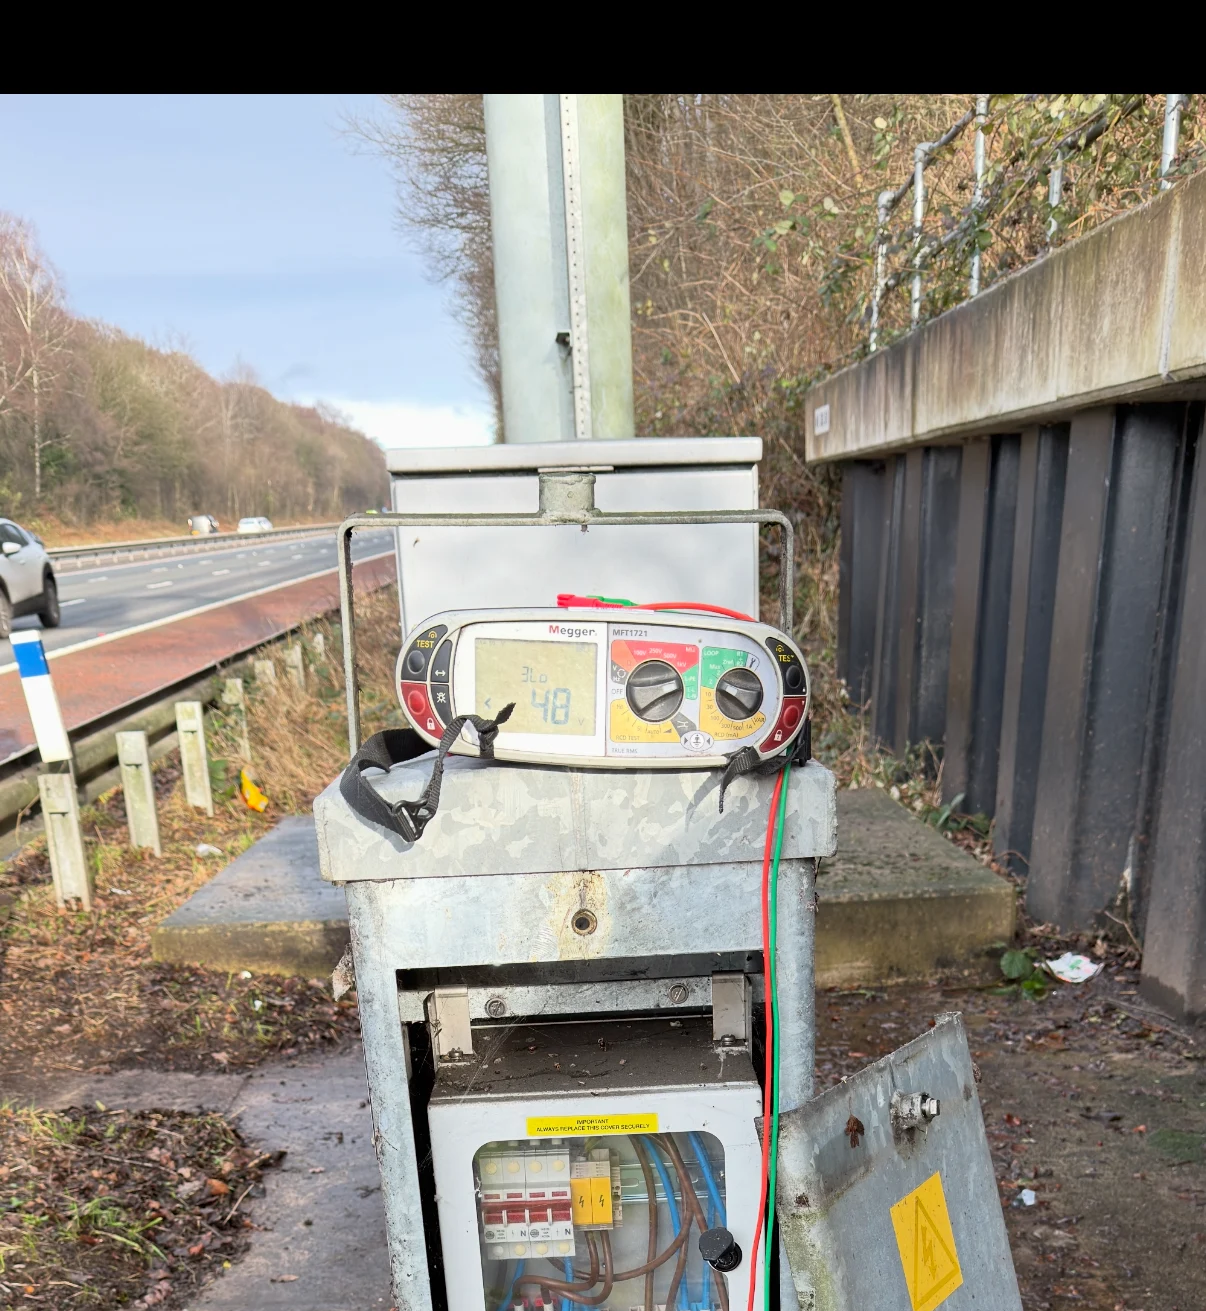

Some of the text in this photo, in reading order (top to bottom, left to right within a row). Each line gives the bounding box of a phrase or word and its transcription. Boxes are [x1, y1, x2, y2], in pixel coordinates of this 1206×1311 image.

[612, 628, 648, 637] MFT1721
[416, 640, 435, 649] TEST
[531, 688, 572, 725] 48
